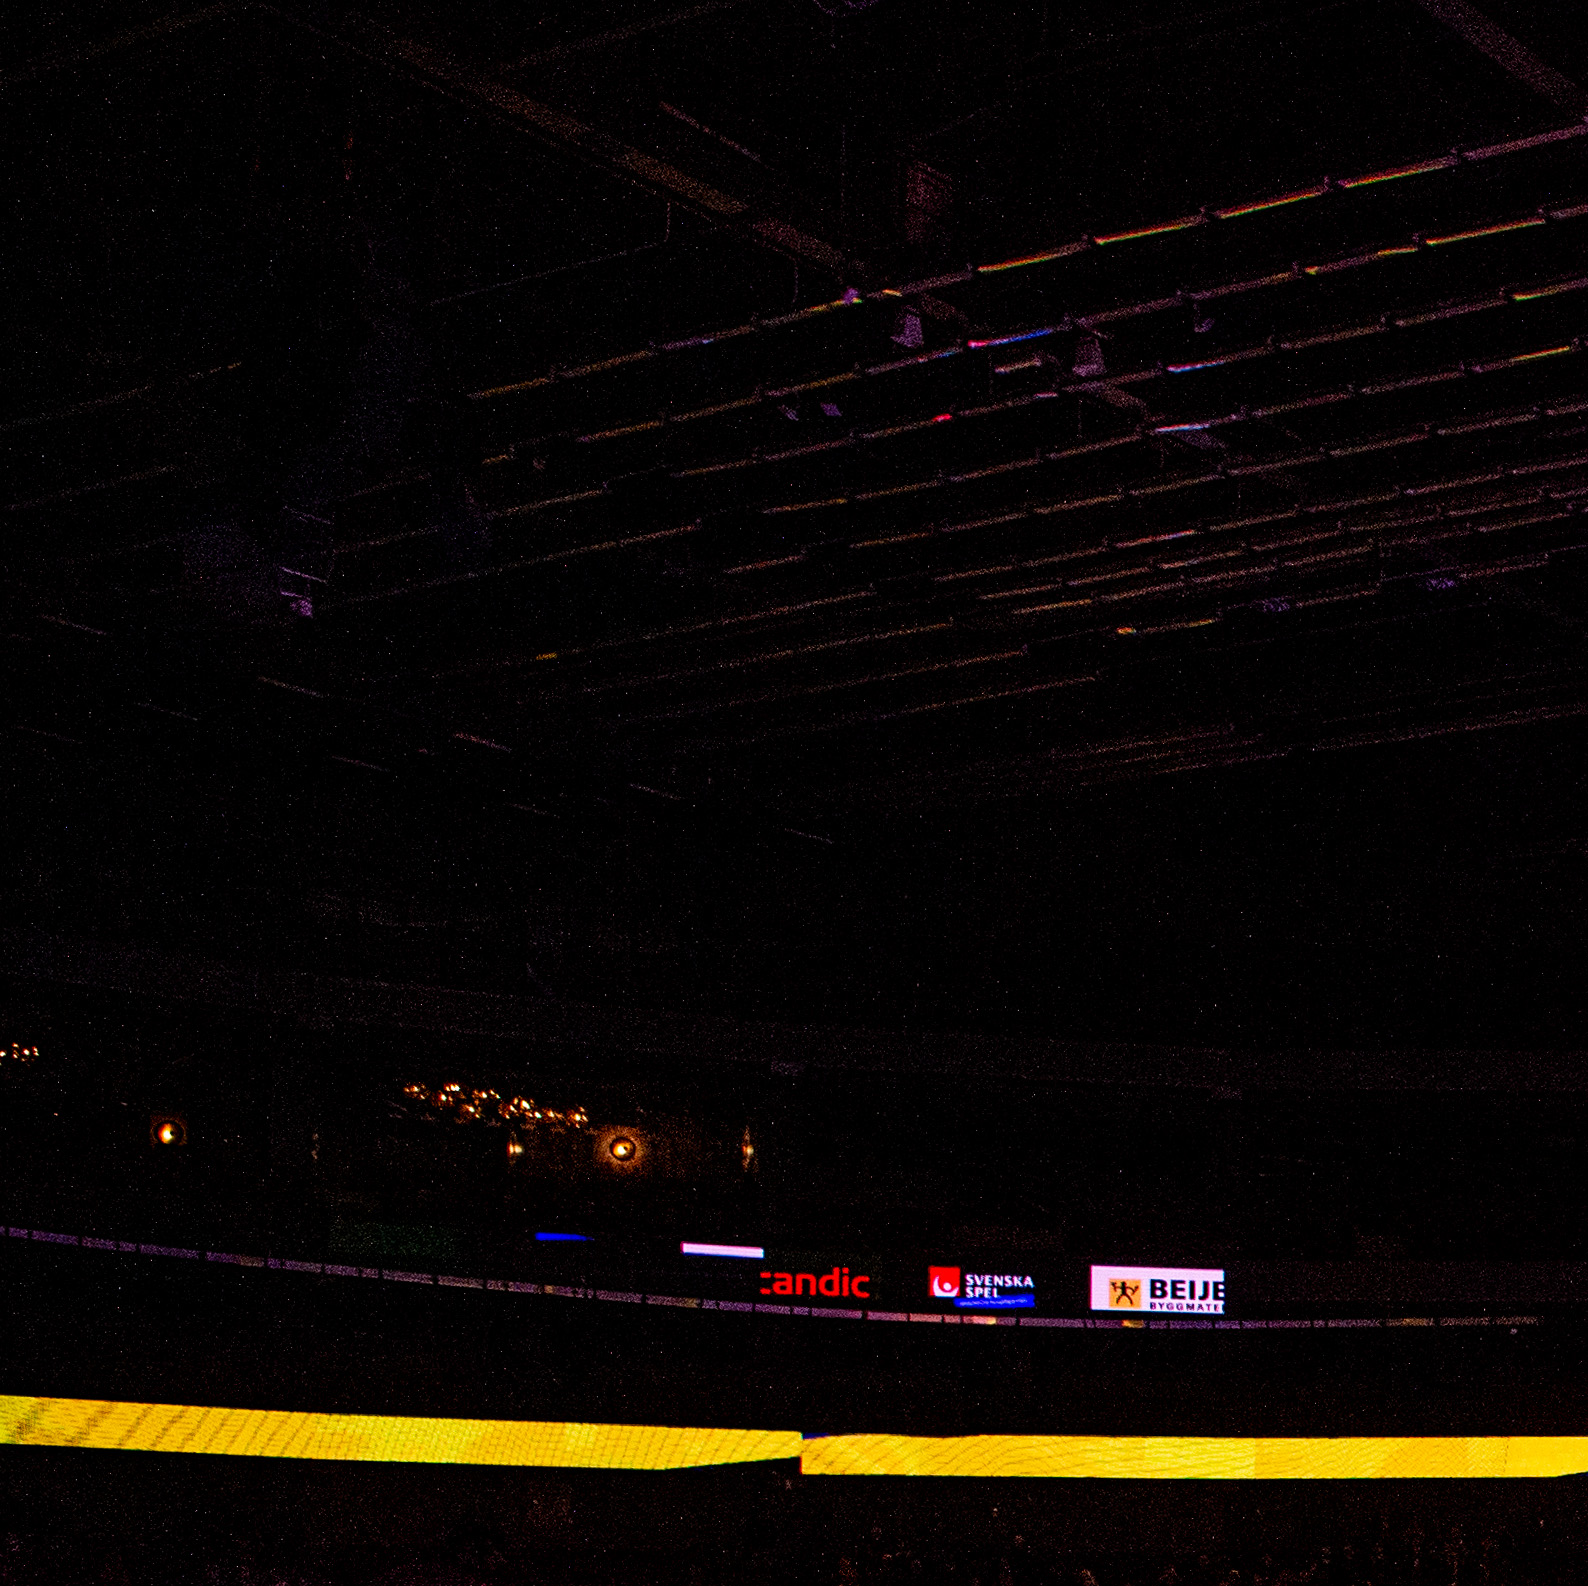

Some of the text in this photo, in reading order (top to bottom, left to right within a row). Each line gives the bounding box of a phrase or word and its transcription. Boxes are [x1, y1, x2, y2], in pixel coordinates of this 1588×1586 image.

[757, 1267, 870, 1298] andic
[965, 1273, 1035, 1289] SVENSKA
[965, 1286, 998, 1299] SPEL
